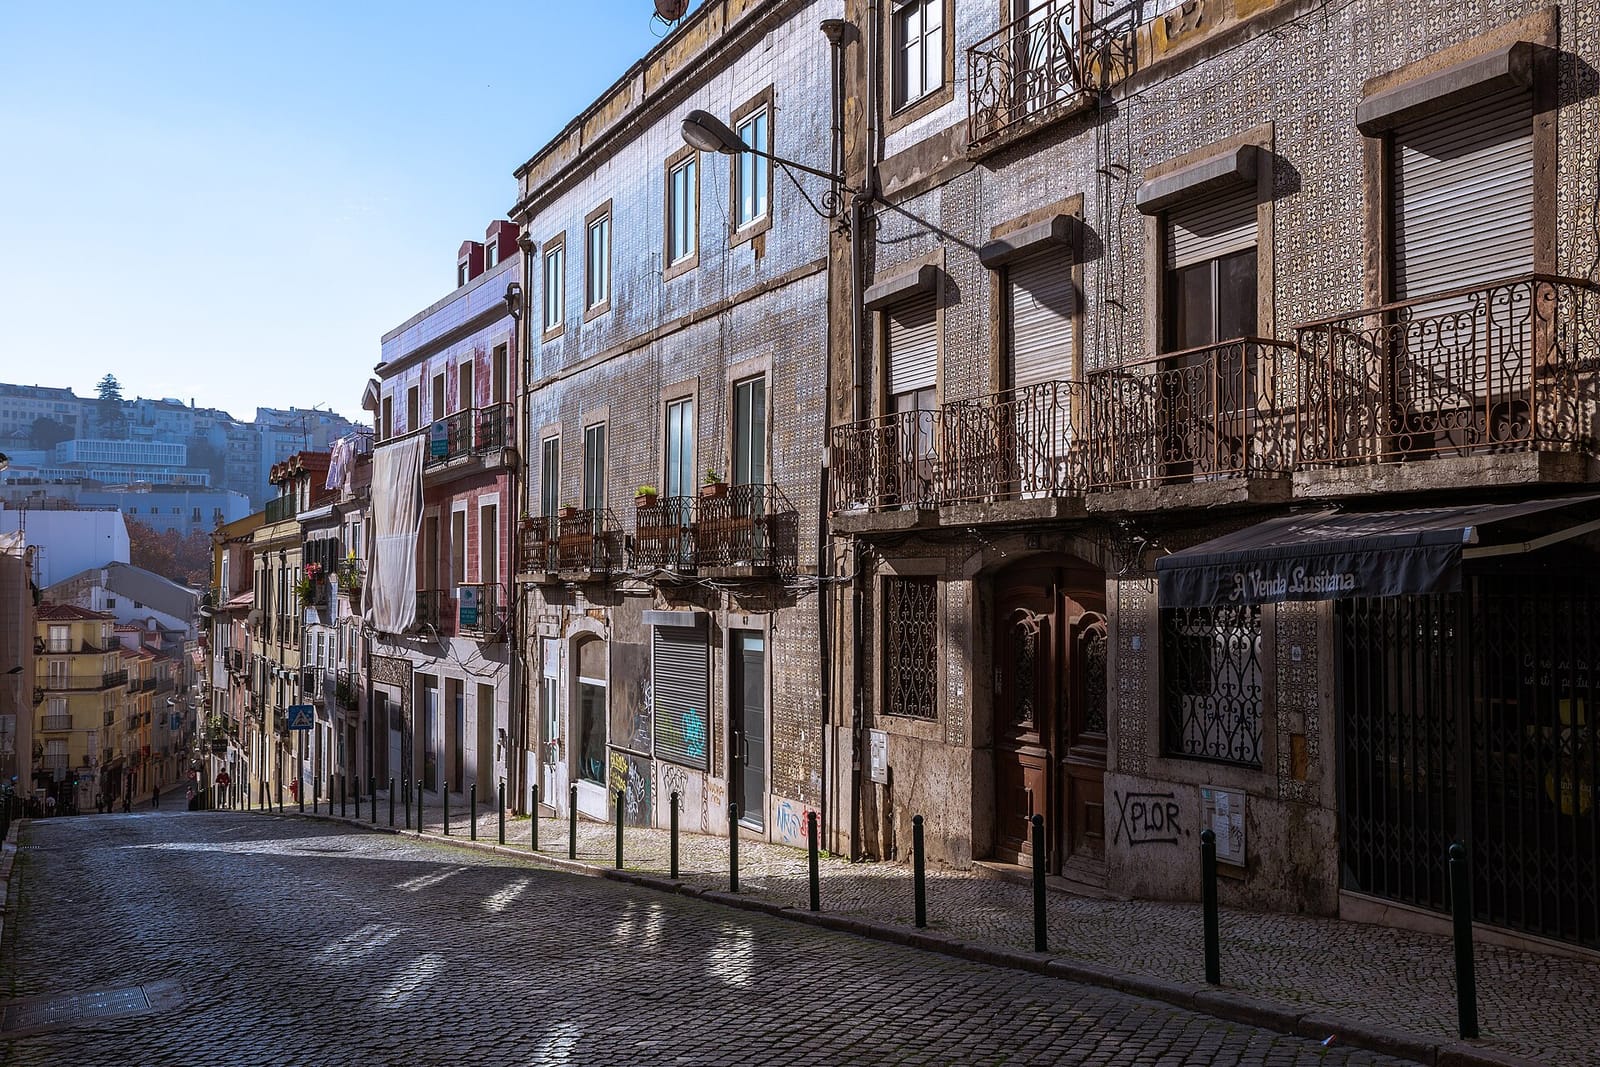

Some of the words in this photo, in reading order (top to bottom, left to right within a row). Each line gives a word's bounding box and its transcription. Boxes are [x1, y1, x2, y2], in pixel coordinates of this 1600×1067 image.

[1229, 572, 1247, 601] A
[1249, 569, 1287, 598] Venda
[1288, 566, 1356, 594] Lusitana
